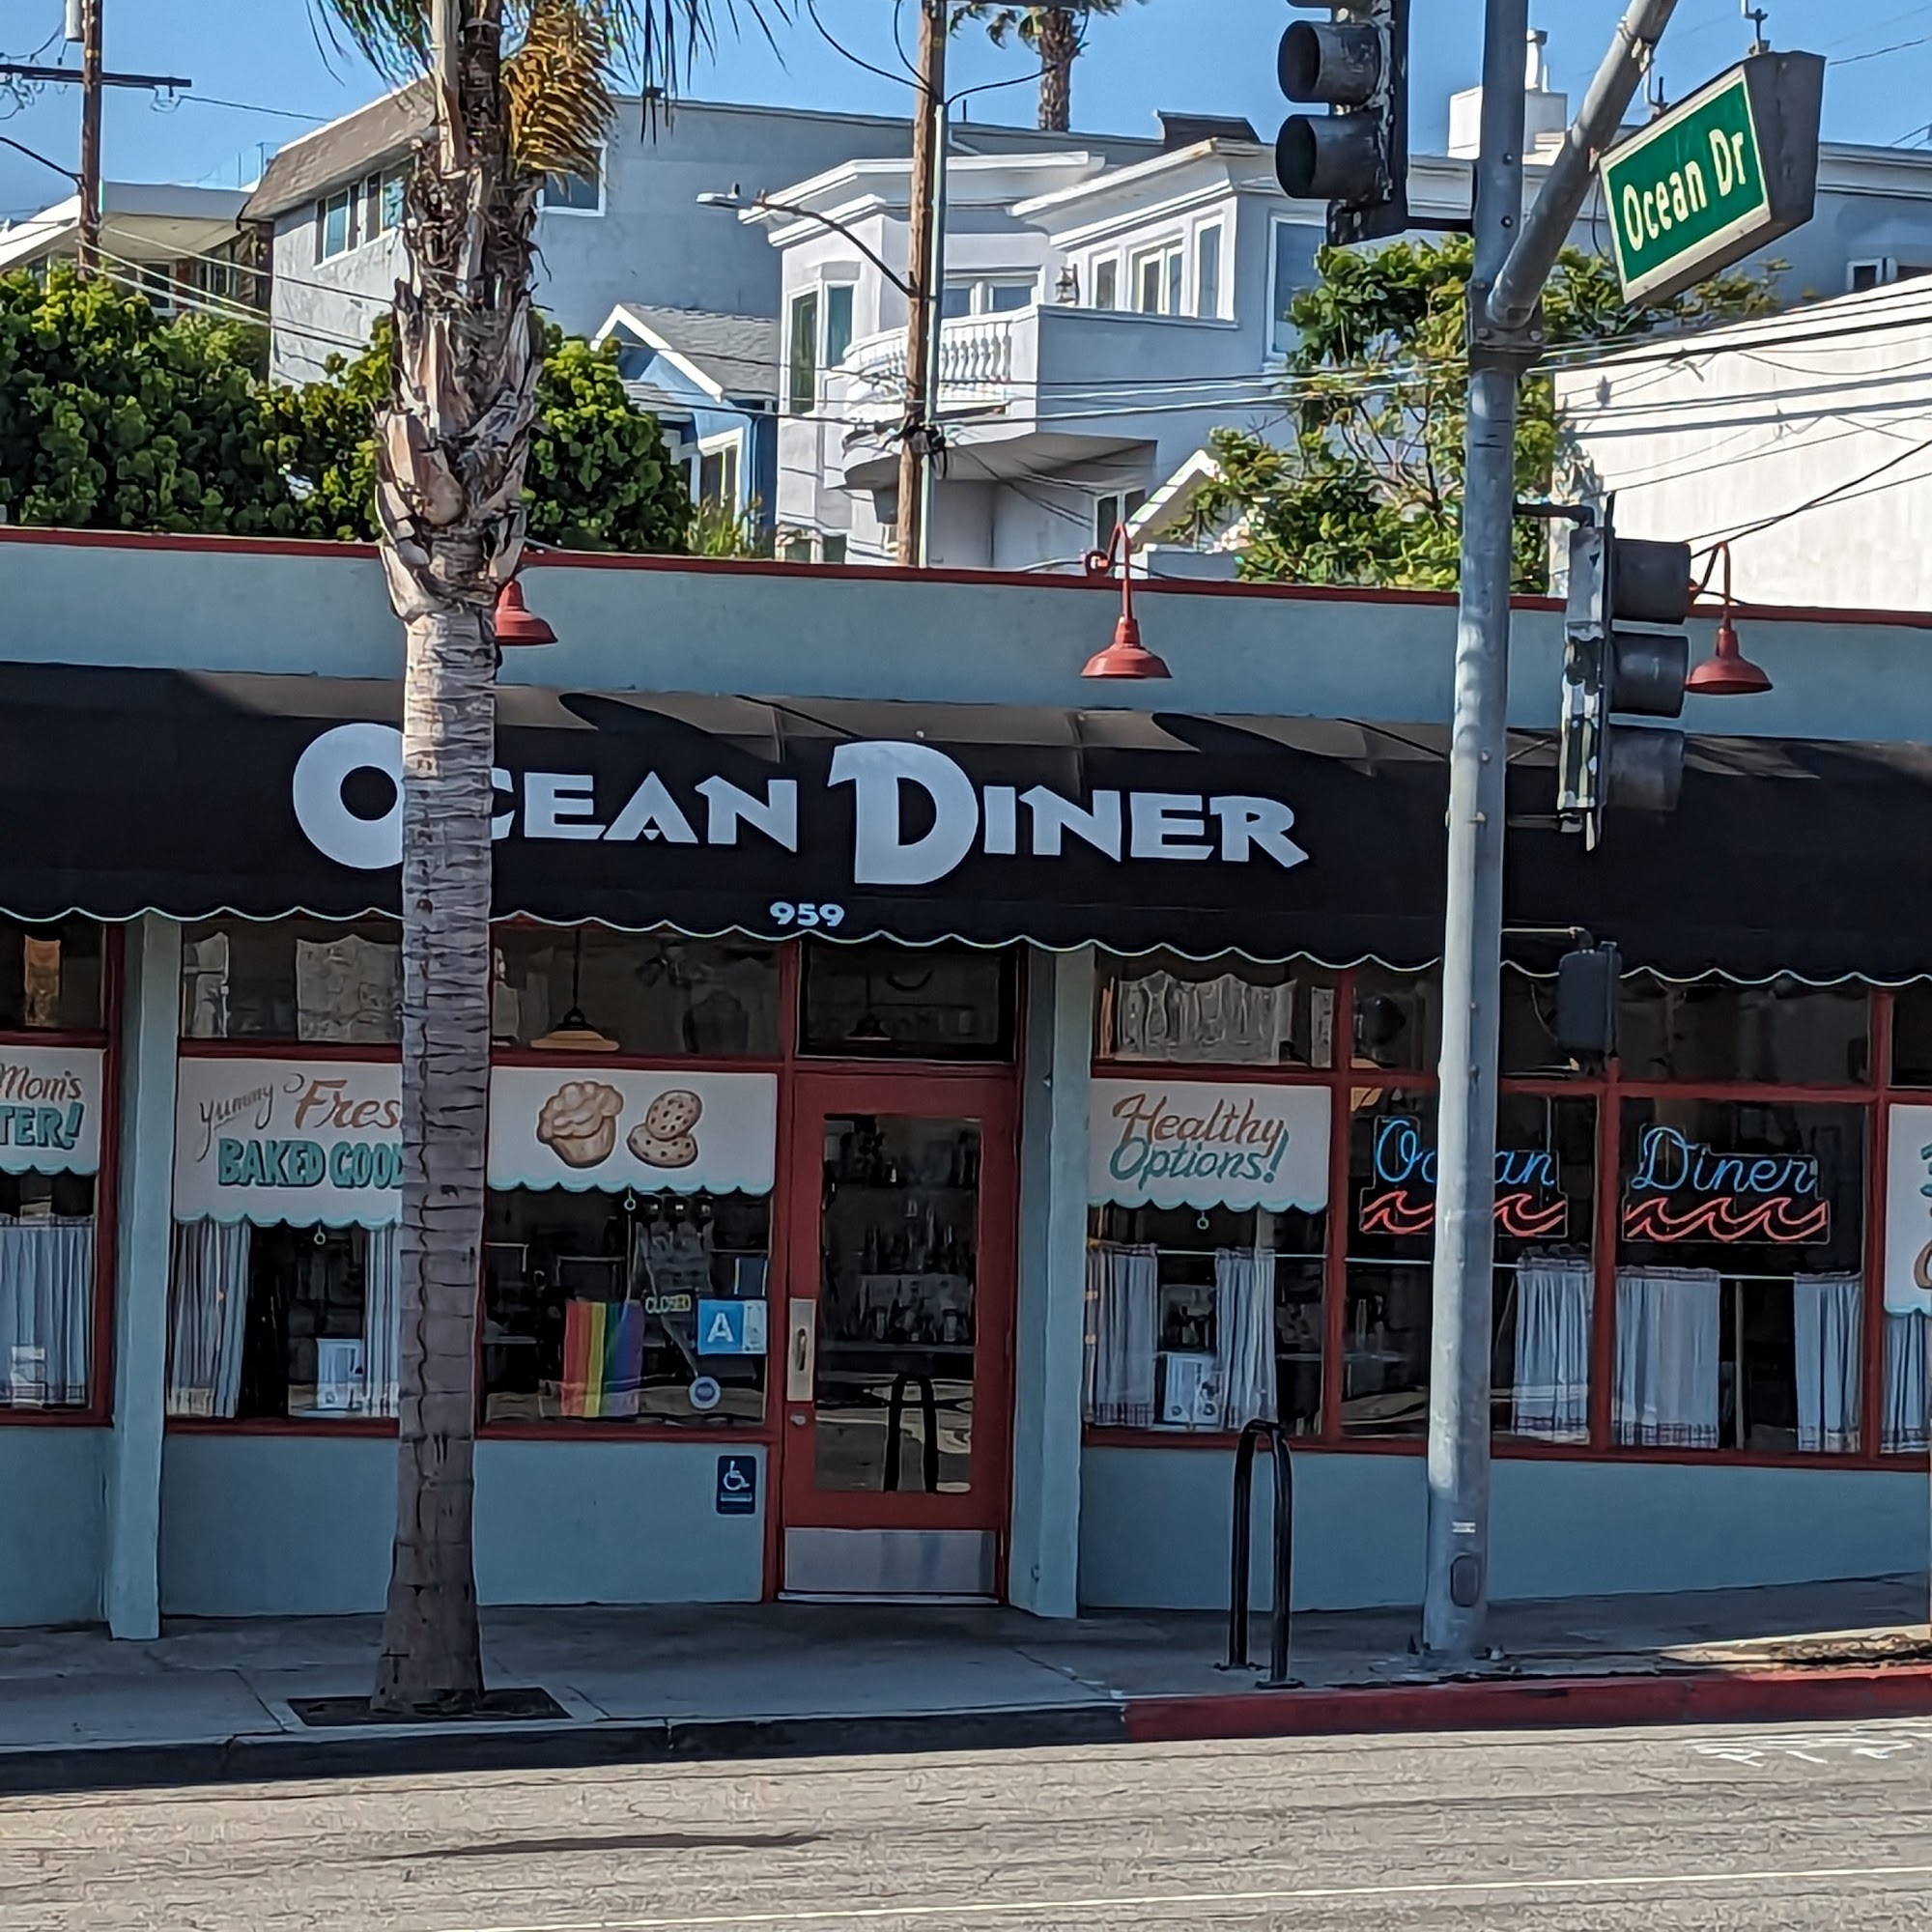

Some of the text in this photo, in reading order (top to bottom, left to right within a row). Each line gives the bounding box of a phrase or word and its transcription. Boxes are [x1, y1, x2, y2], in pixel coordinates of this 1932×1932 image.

[1623, 128, 1747, 251] Ocean Dr
[828, 740, 1309, 885] DINER
[770, 901, 845, 927] 959
[0, 1063, 82, 1101] Mom's
[283, 1073, 402, 1129] Fres
[1112, 1093, 1285, 1159] Healthy
[218, 1138, 403, 1189] BAKED GOO
[1110, 1129, 1290, 1190] Options!
[1377, 1120, 1818, 1194] Ocan Diner
[707, 1312, 734, 1343] A
